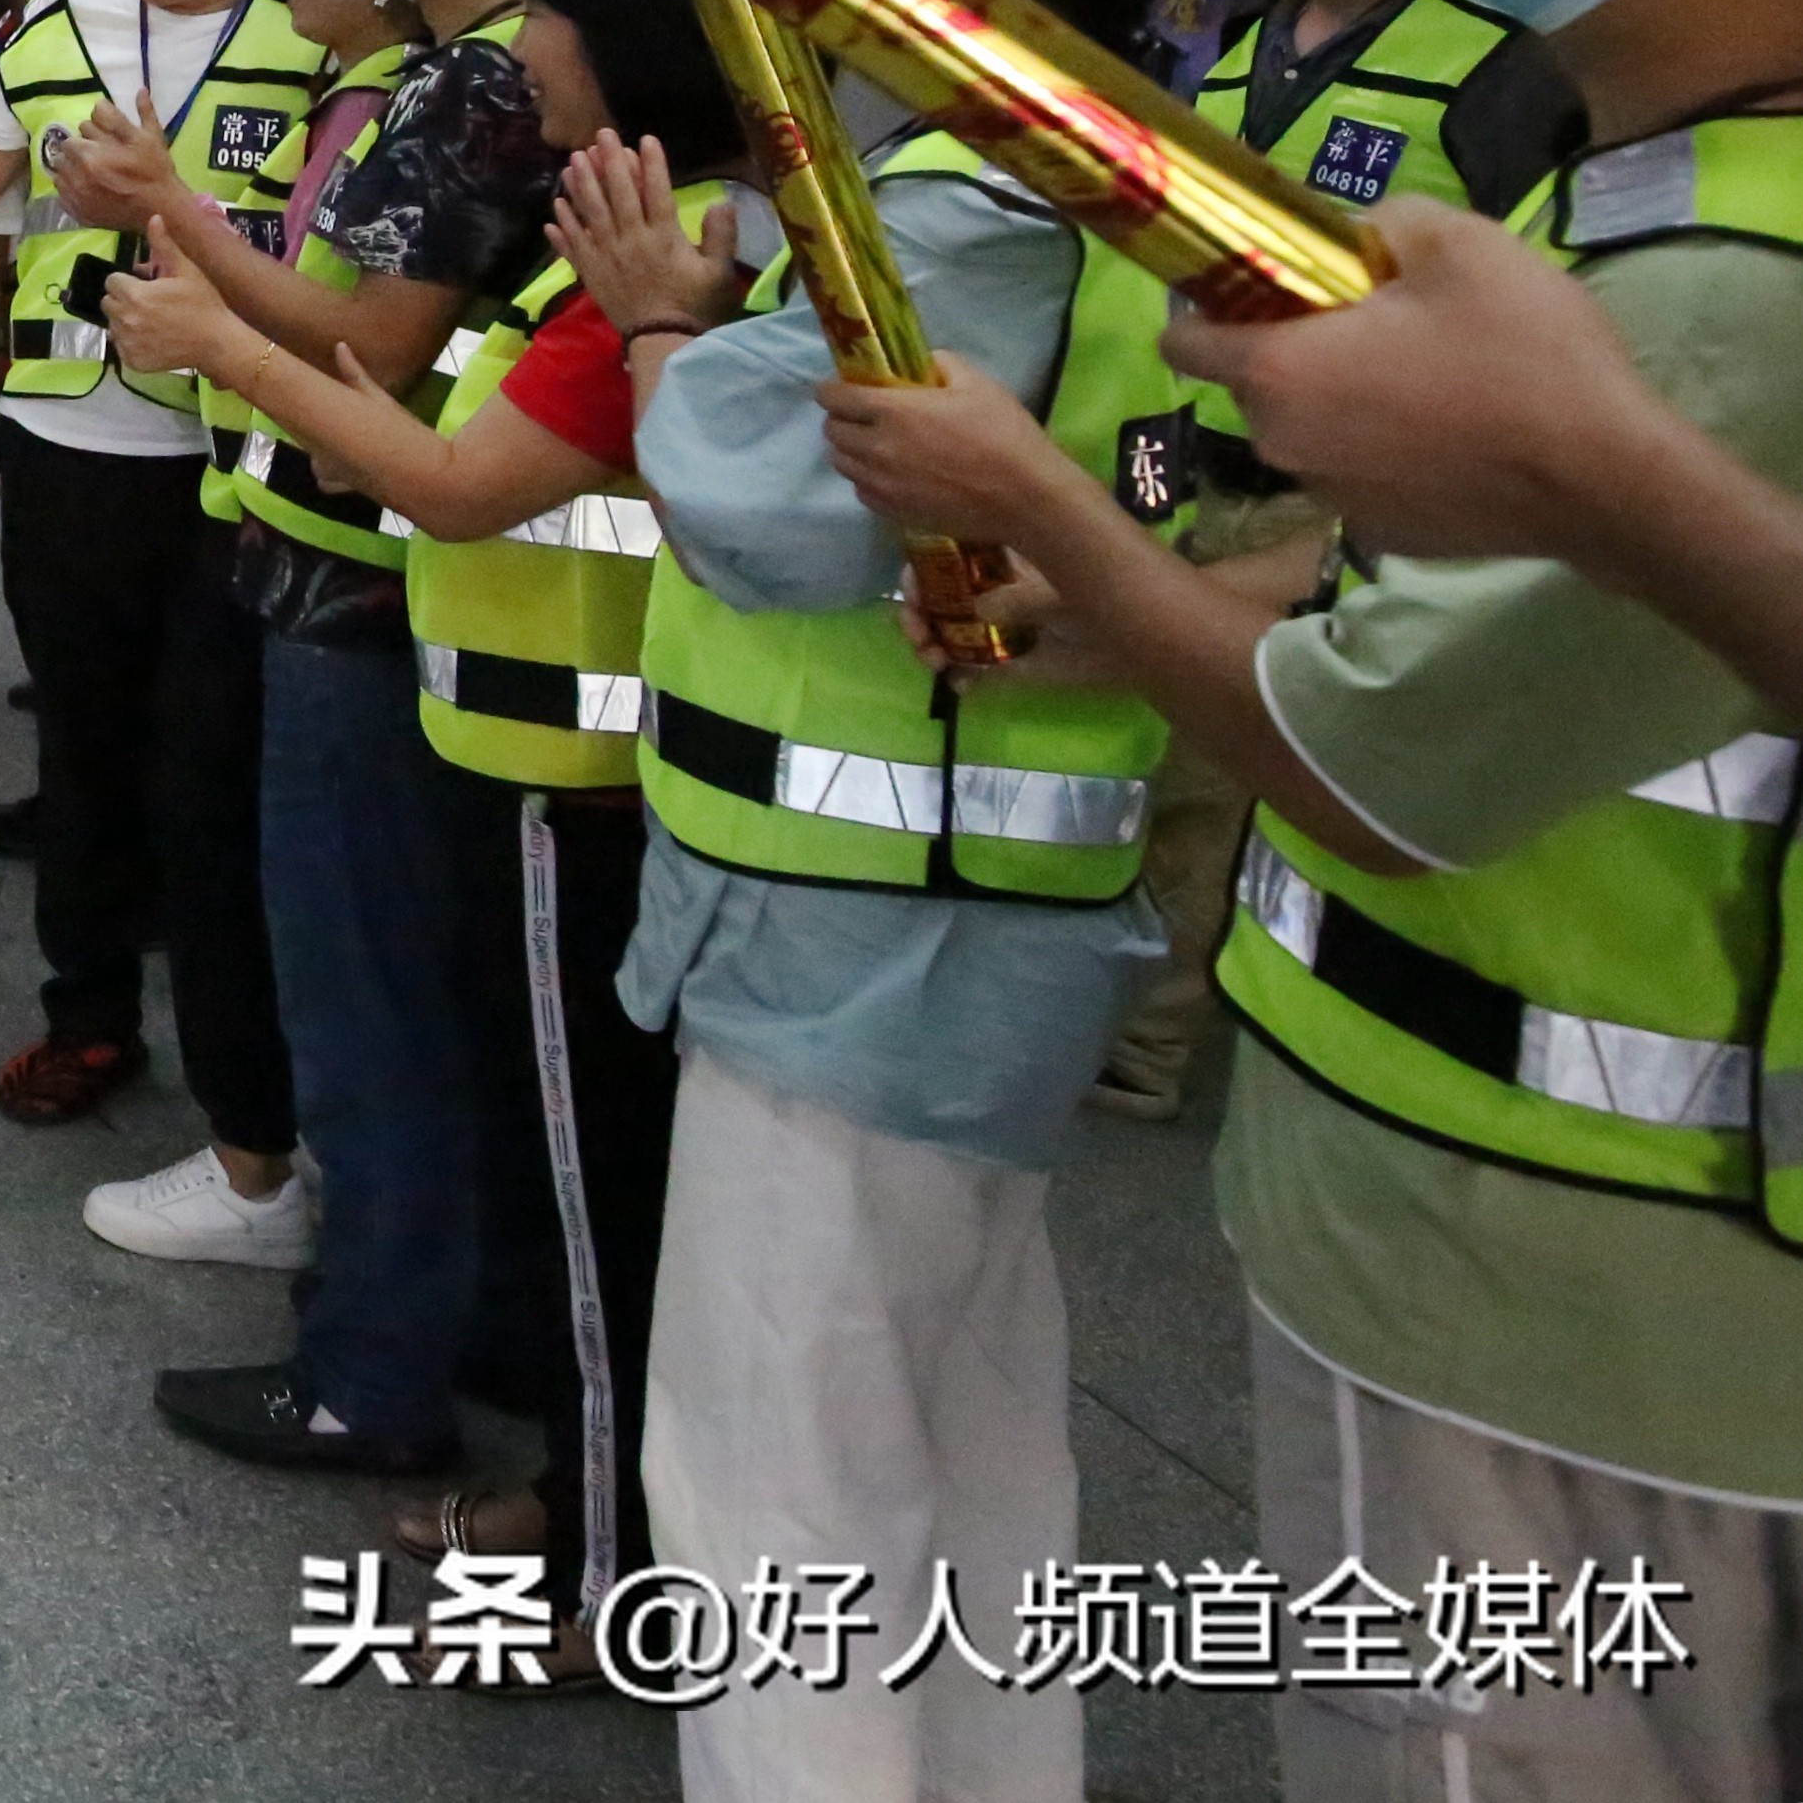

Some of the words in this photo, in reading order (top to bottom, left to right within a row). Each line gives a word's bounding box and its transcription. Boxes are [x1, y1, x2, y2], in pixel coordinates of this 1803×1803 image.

[222, 112, 280, 148] 常平
[1328, 121, 1393, 172] 常平
[1316, 164, 1378, 198] 04819
[233, 216, 282, 253] 常平
[531, 916, 553, 992] Superdry
[543, 1044, 566, 1120] Superdry
